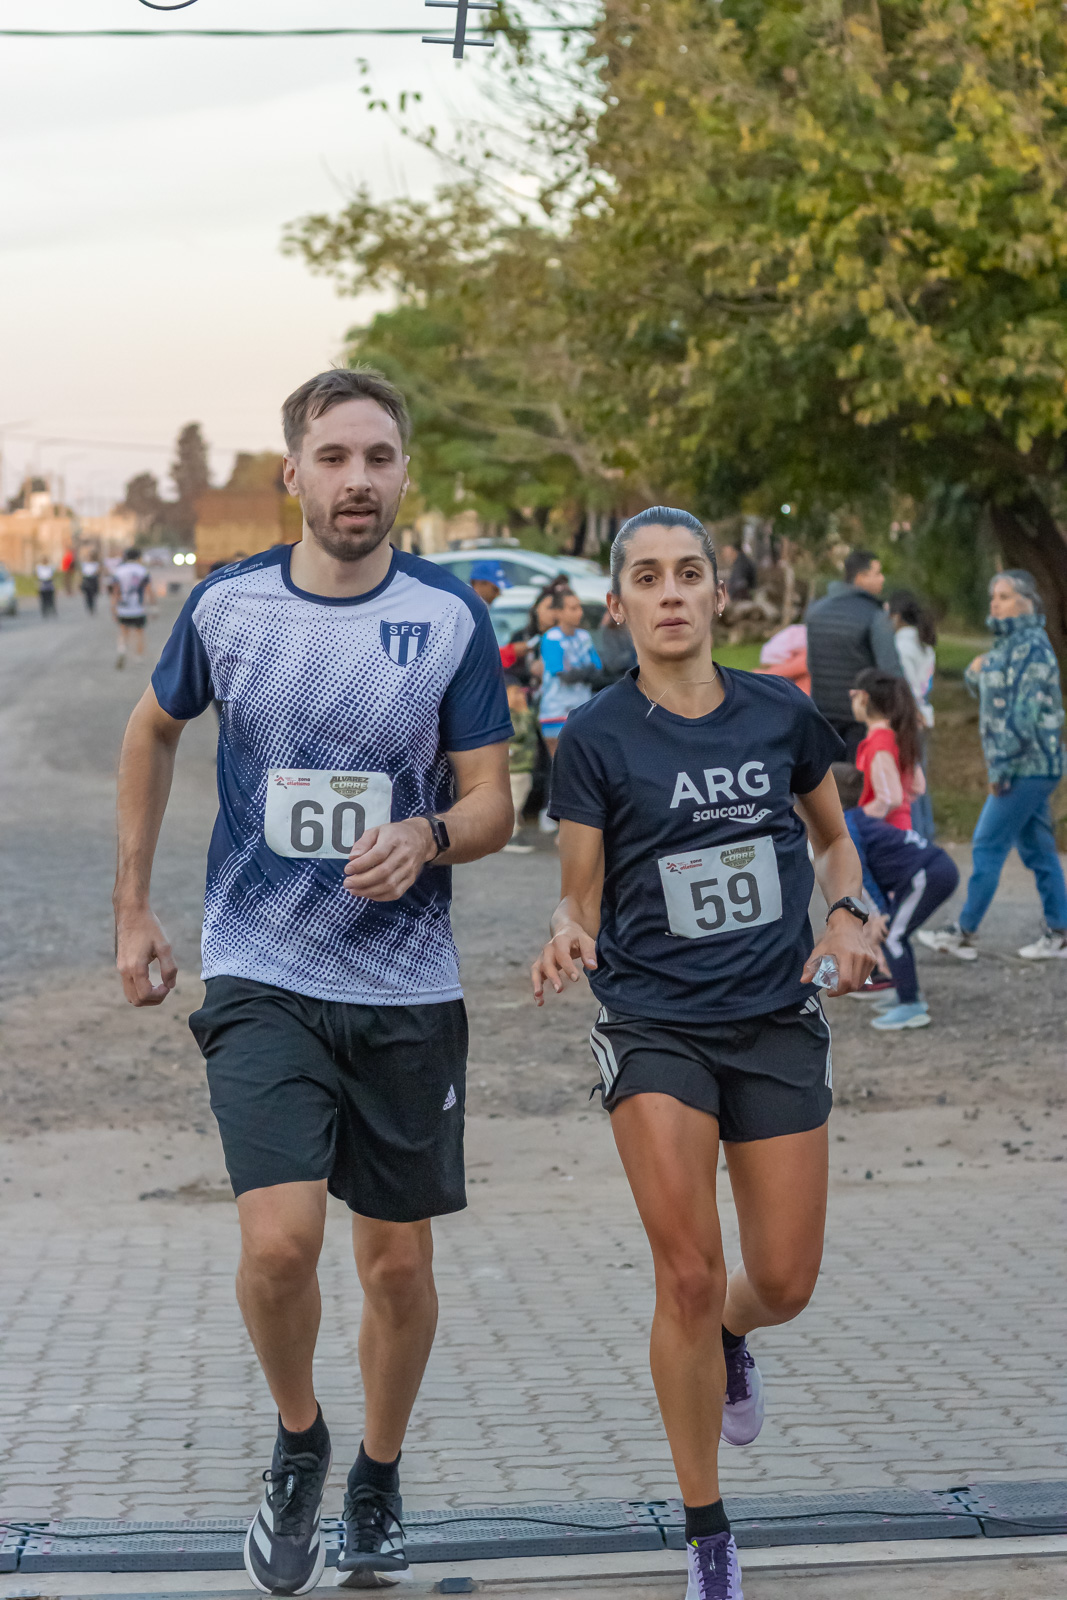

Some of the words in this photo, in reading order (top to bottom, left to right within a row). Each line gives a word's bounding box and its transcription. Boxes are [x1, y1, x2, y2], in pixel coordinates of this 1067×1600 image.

[389, 625, 422, 636] SFC
[669, 761, 771, 808] ARG
[290, 800, 366, 854] 60
[692, 803, 756, 822] saucony
[723, 851, 755, 863] CORRE
[690, 872, 761, 930] 59
